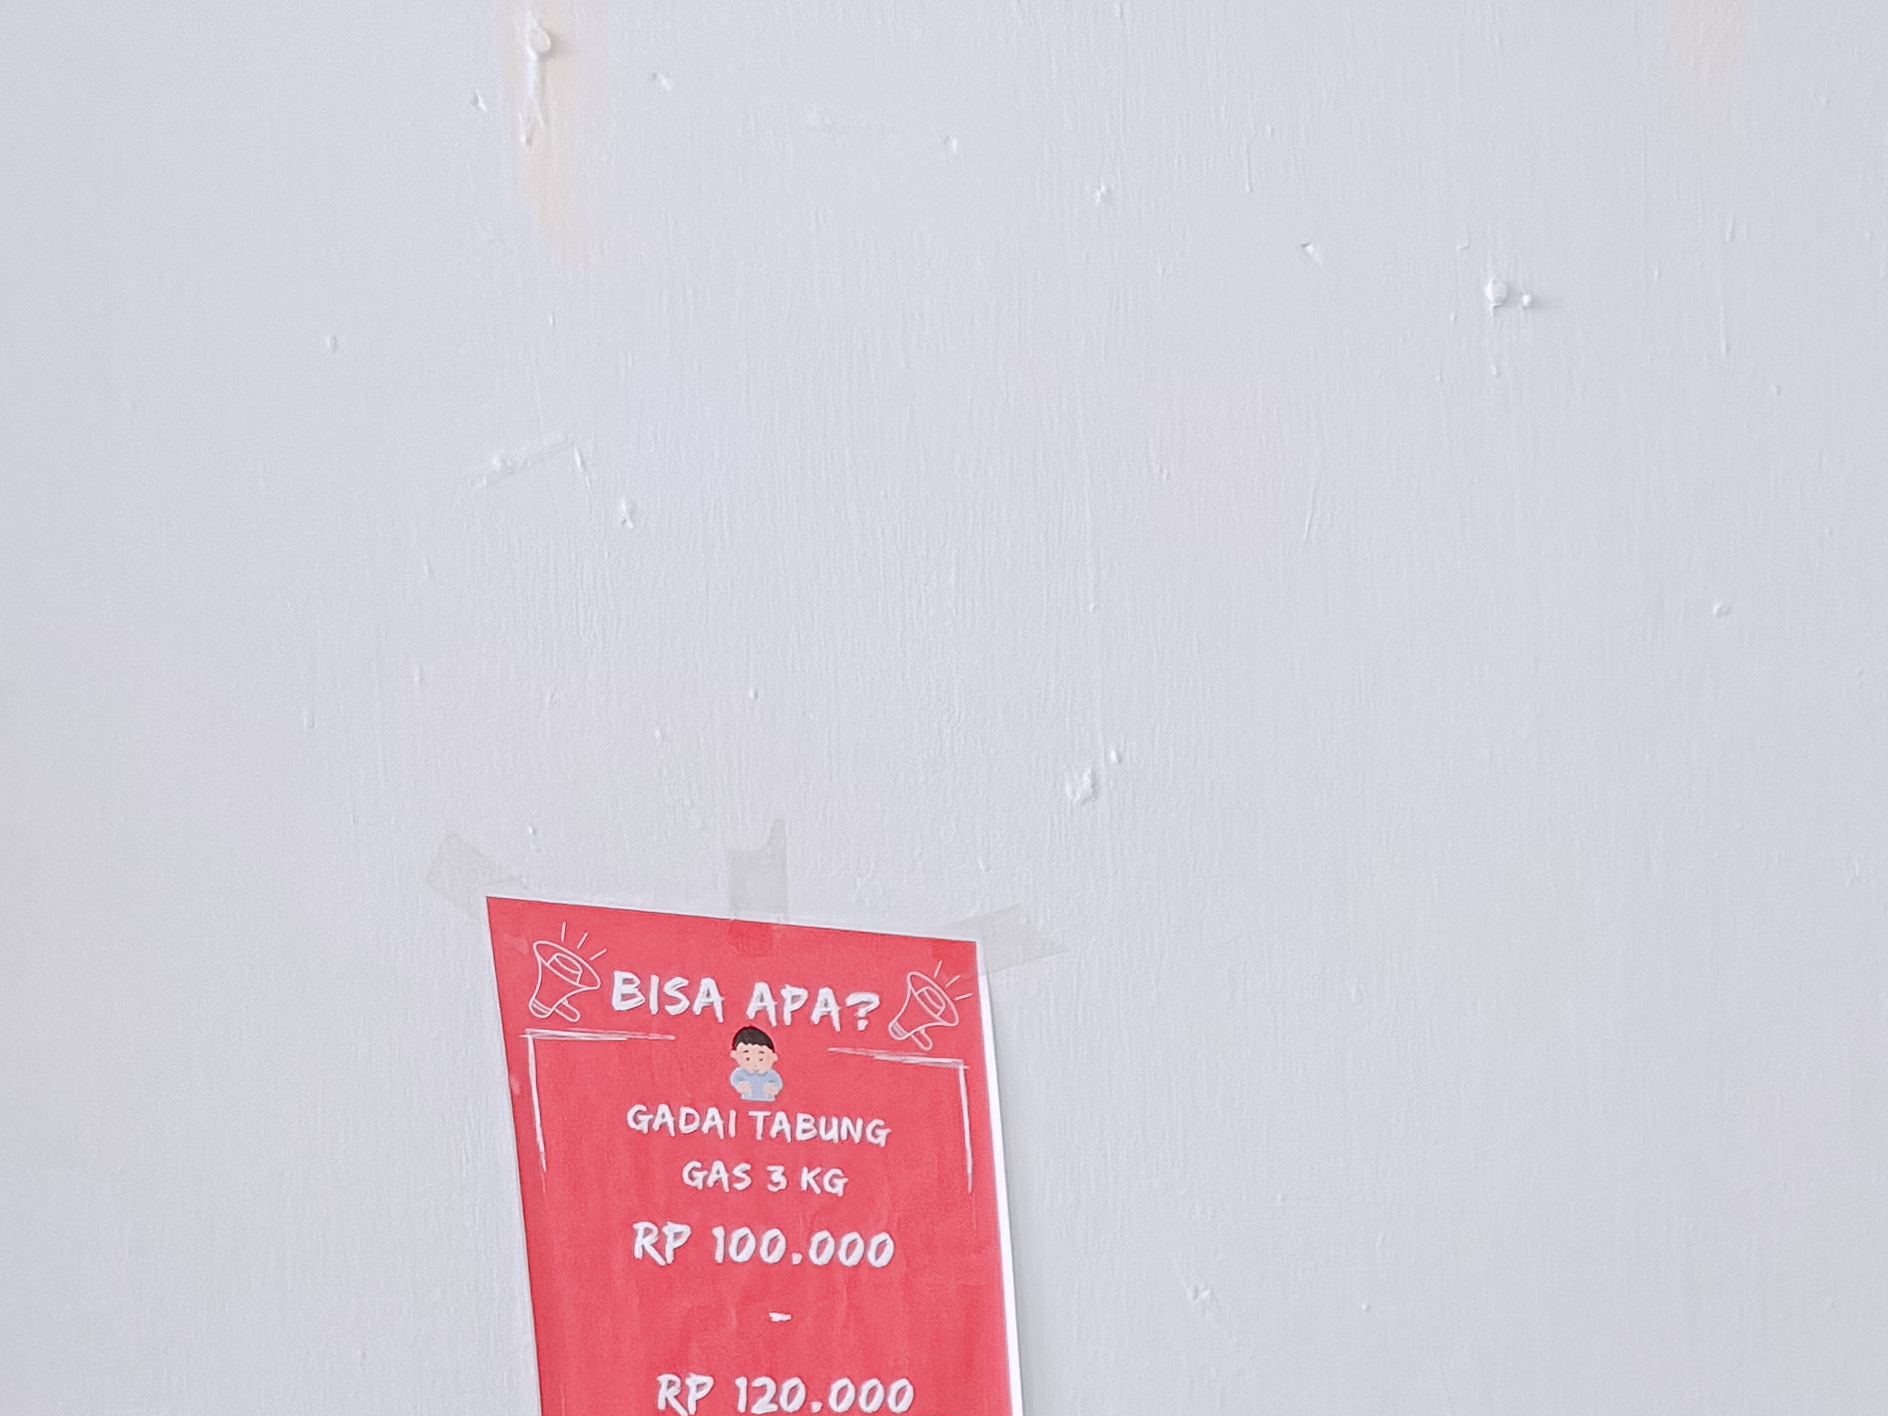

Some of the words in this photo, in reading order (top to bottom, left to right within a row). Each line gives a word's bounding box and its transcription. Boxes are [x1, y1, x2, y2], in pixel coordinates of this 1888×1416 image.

[611, 970, 725, 1023] BISA
[745, 981, 880, 1032] APA?
[626, 1103, 737, 1140] GADAI
[748, 1110, 891, 1148] TABUNG
[682, 1160, 752, 1193] GAS
[766, 1165, 787, 1192] 3
[800, 1166, 849, 1197] KG
[632, 1221, 692, 1266] RP
[712, 1226, 895, 1268] 100.000
[734, 1376, 914, 1415] 120.000
